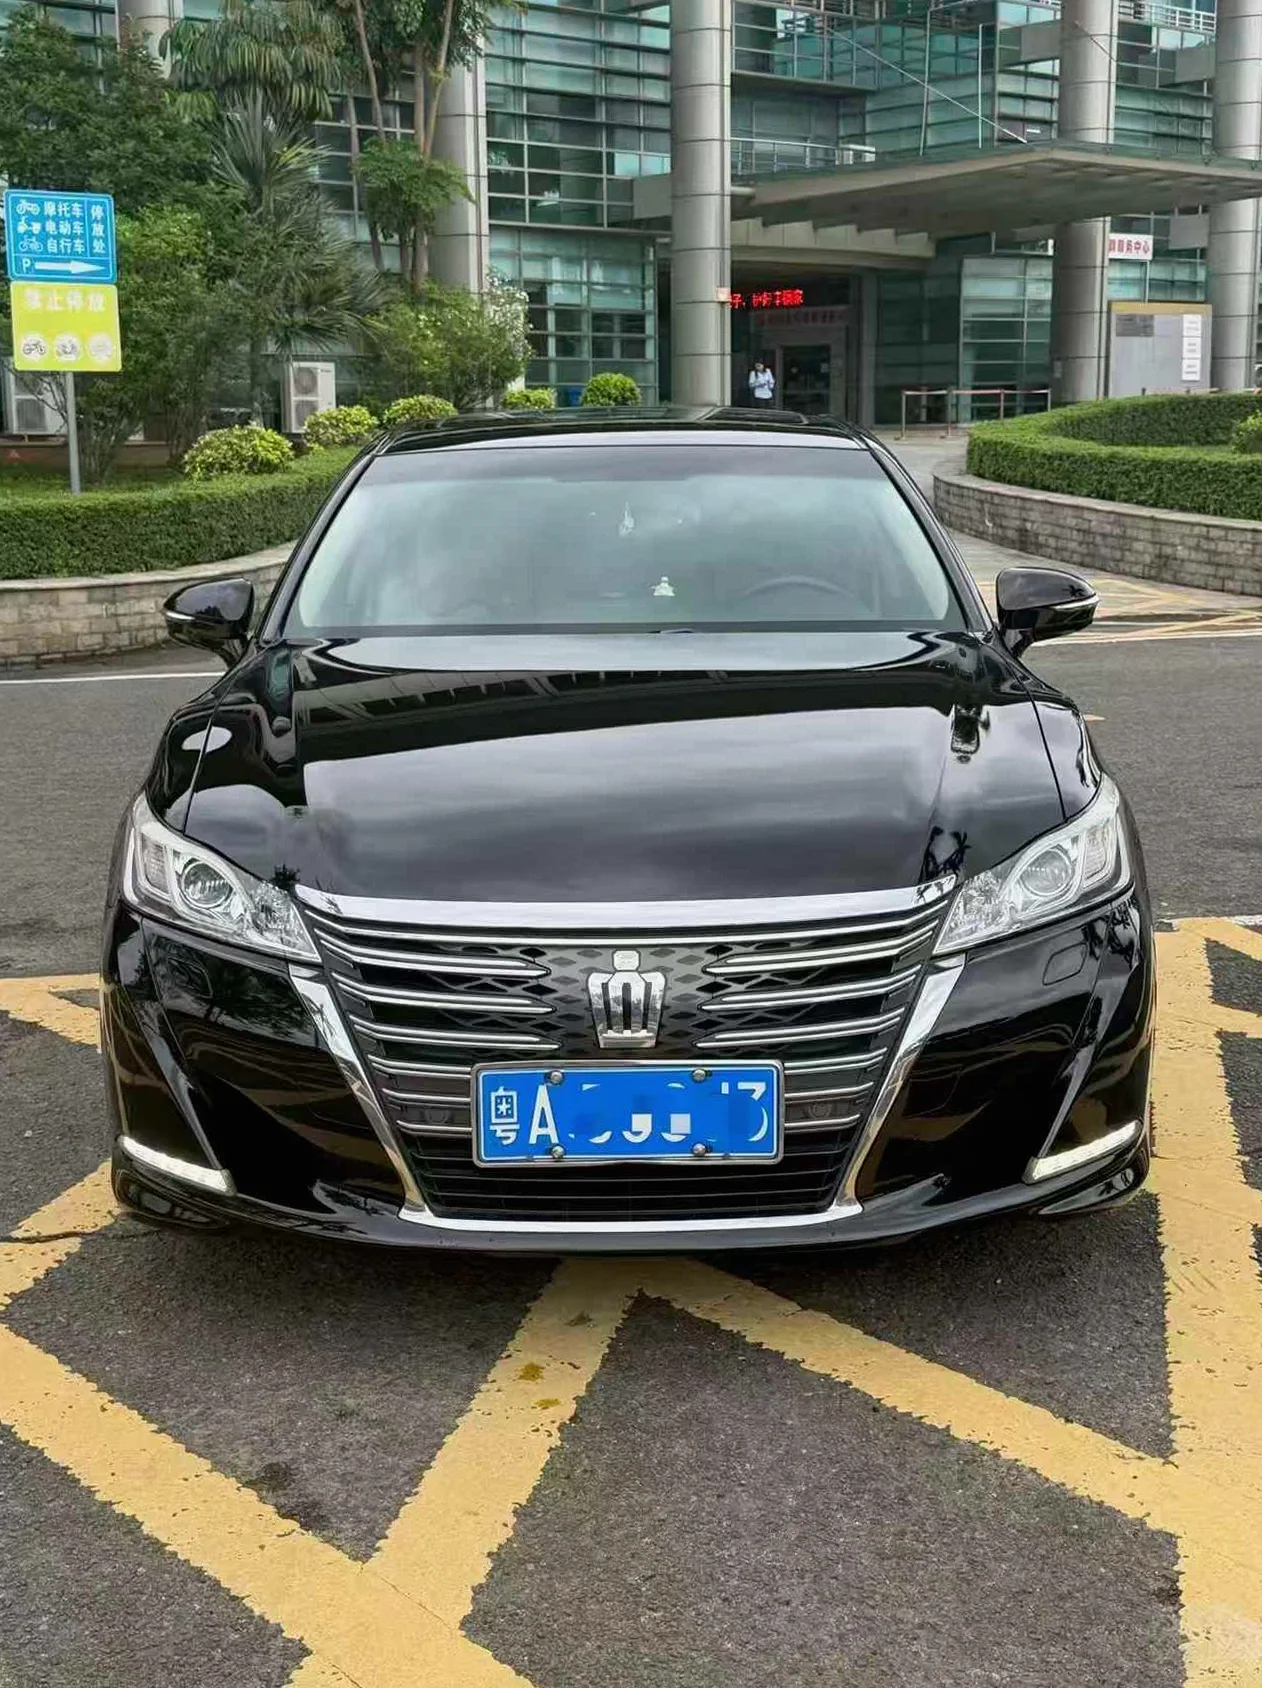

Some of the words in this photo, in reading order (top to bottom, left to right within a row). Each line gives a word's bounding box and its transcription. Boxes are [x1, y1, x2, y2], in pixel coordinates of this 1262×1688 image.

[43, 202, 84, 218] 摩托车
[45, 219, 85, 236] 电动车
[91, 205, 106, 253] 停放处
[46, 237, 86, 254] 自行车
[22, 258, 31, 273] P
